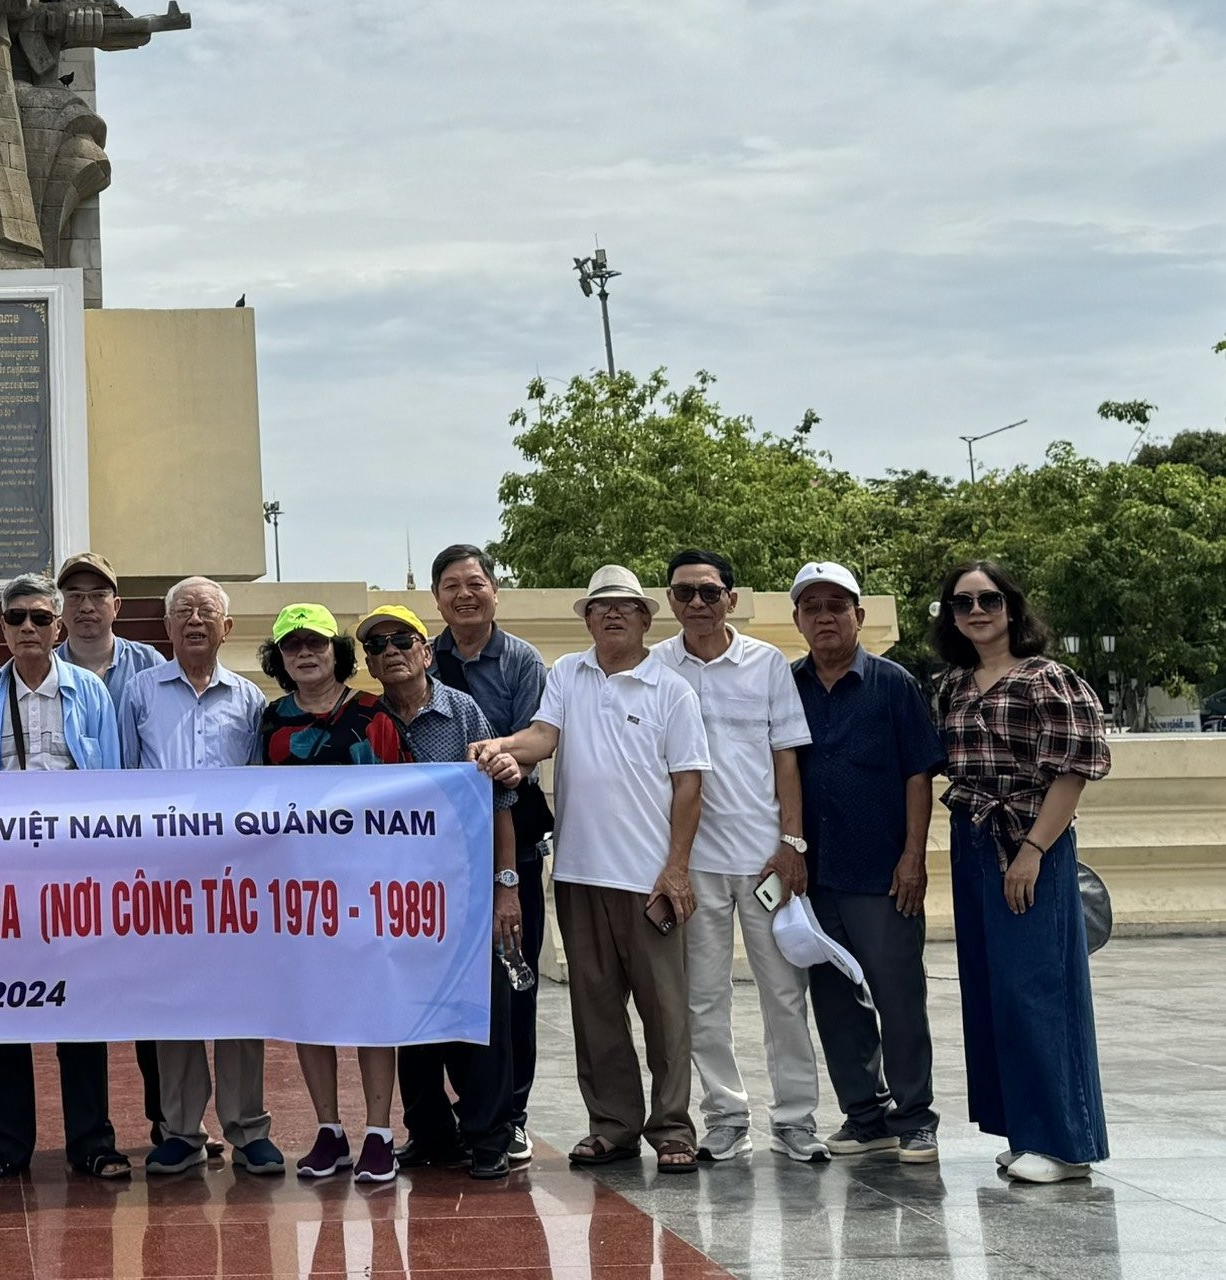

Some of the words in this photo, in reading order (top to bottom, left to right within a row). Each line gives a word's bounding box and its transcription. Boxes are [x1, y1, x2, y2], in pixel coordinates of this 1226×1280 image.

[70, 814, 143, 839] NAM
[152, 805, 224, 837] TỈNH
[234, 802, 355, 836] QUẢNG
[365, 809, 437, 836] NAM
[39, 876, 102, 945] (NƠI
[111, 868, 193, 937] CÔNG
[201, 866, 258, 935] TÁC
[268, 878, 338, 938] 1979
[348, 906, 360, 918] -
[369, 880, 448, 943] 1989)
